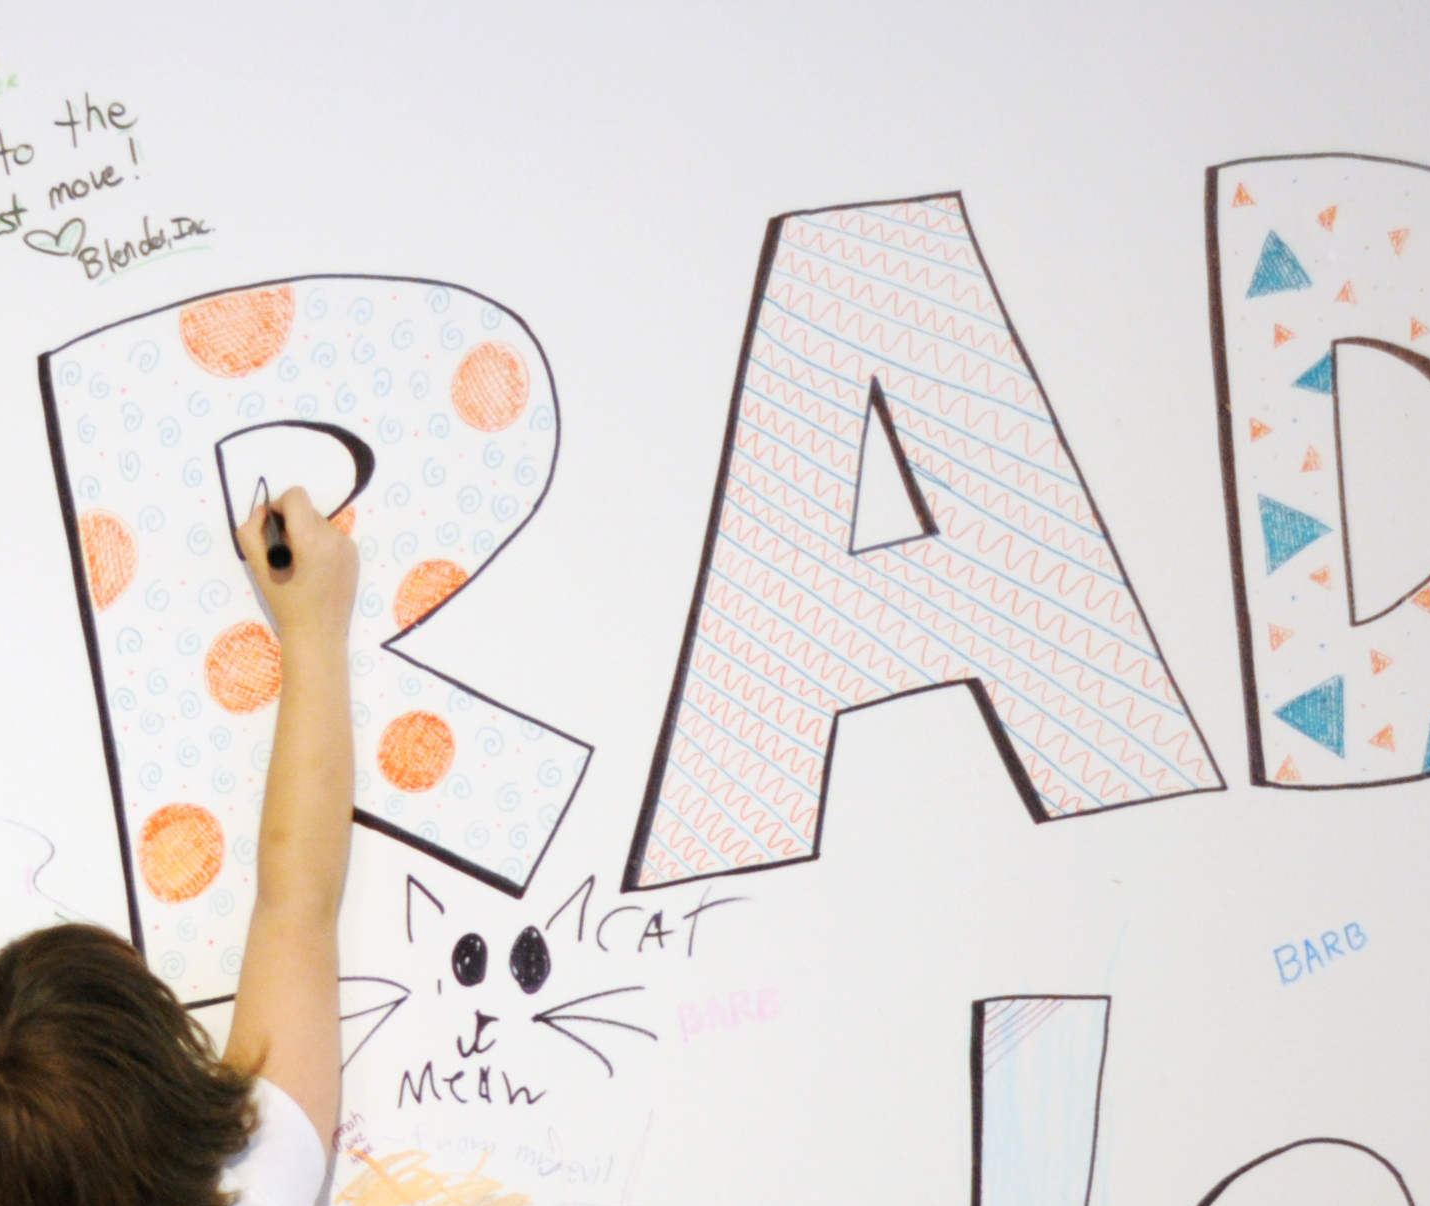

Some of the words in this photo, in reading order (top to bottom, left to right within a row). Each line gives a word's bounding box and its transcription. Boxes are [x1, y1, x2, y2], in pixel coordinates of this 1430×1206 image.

[54, 92, 138, 148] the
[47, 137, 145, 210] move!
[596, 886, 753, 958] CAT
[1272, 920, 1368, 986] BARB
